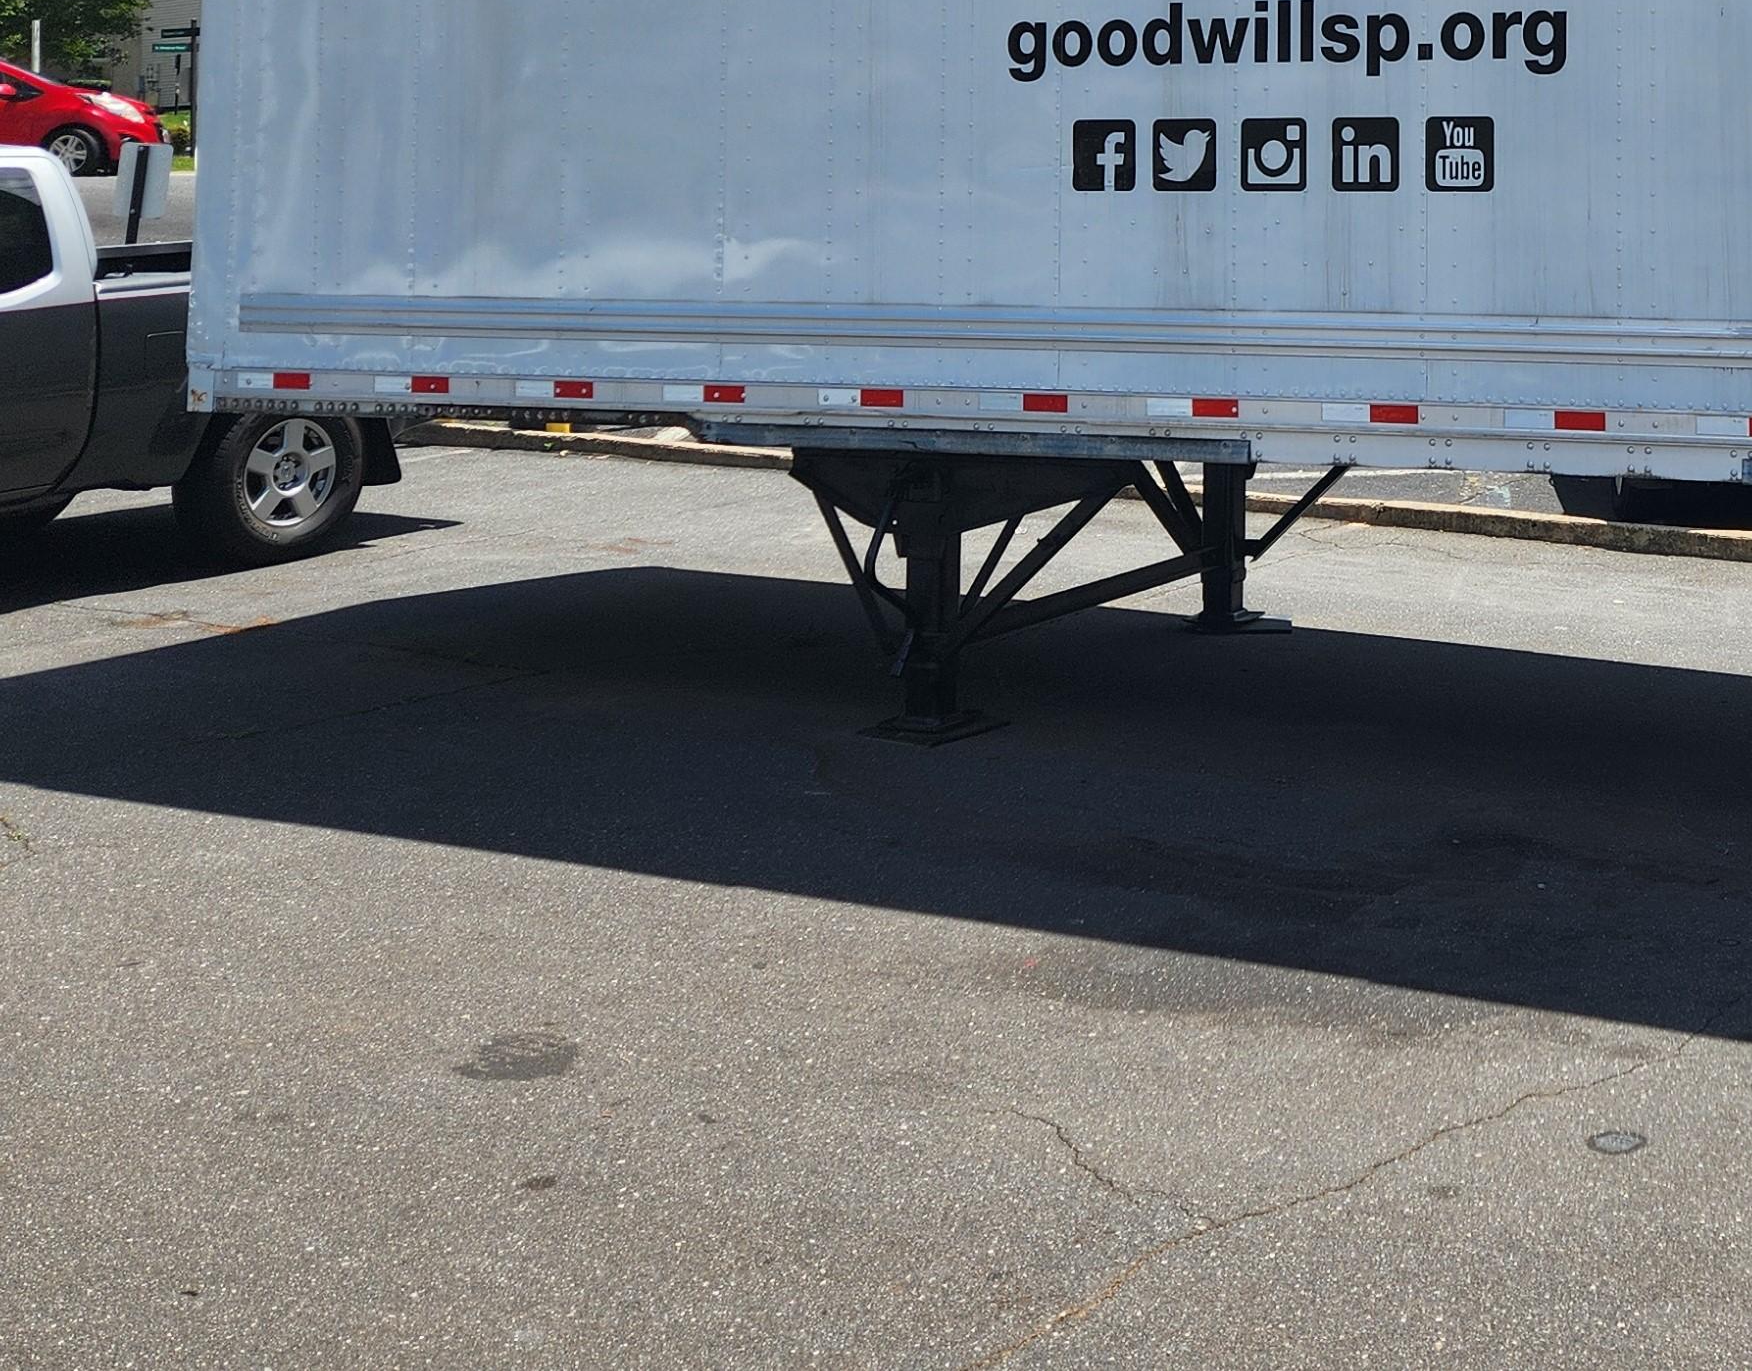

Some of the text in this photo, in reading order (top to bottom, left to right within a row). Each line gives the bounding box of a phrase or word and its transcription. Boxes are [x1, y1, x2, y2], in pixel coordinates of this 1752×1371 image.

[1007, 0, 1568, 82] goodwillsp.org
[1441, 120, 1475, 147] You
[1438, 155, 1482, 181] Tube
